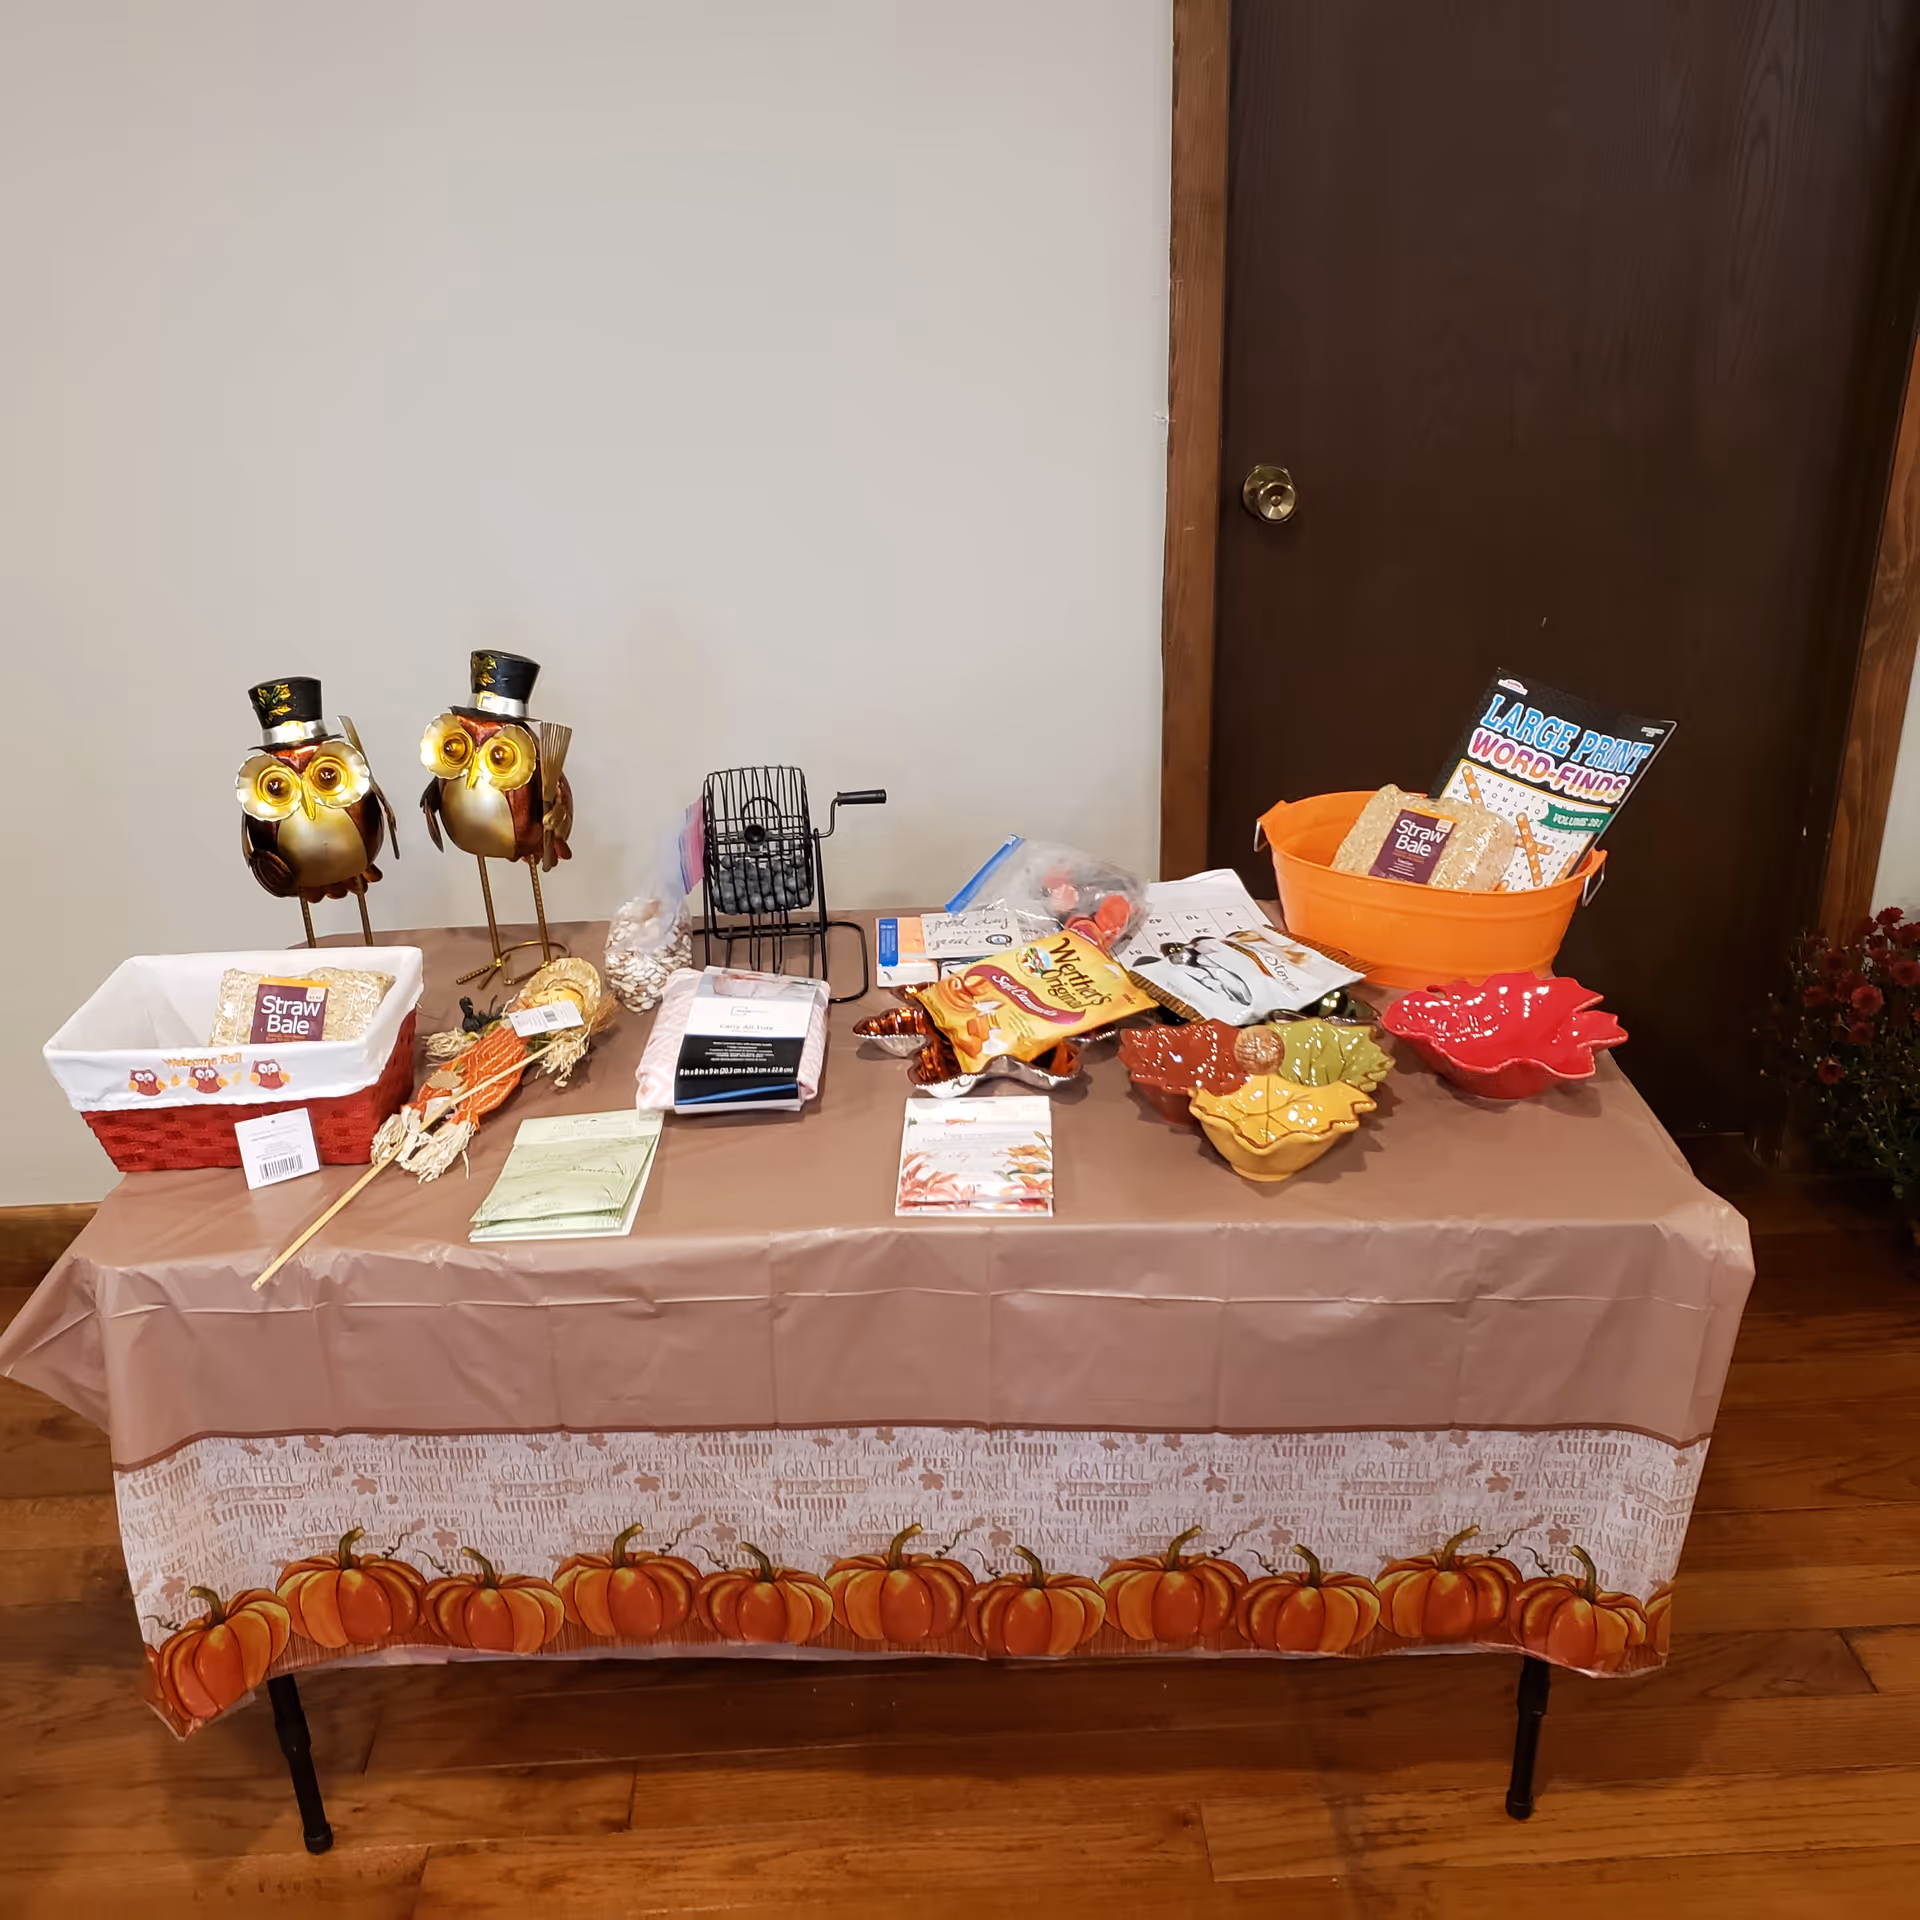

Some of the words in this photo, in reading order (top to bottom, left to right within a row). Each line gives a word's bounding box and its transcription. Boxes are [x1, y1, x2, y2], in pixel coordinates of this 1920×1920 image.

[1481, 694, 1580, 757] LARGE
[1573, 731, 1655, 774] PRINT
[1468, 727, 1630, 803] WORD-FINDS
[1396, 819, 1446, 843] Straw
[1395, 834, 1431, 856] Bale
[1049, 937, 1112, 1006] Werther's
[1041, 969, 1092, 1009] Original
[261, 995, 321, 1017] Straw
[267, 1014, 310, 1035] Bale
[408, 1444, 487, 1460] Autumn
[695, 1442, 772, 1457] Autumn
[983, 1441, 1058, 1457] Autumn
[1271, 1443, 1346, 1458] Autumn
[1557, 1441, 1632, 1458] Autumn
[352, 1462, 380, 1474] PIE
[637, 1460, 665, 1471] PIE
[784, 1459, 860, 1477] GRATEFUL
[922, 1458, 950, 1469] PIE
[1068, 1462, 1149, 1481] GRATEFUL
[1208, 1463, 1234, 1473] PIE
[1355, 1461, 1433, 1479] GRATEFUL
[1491, 1461, 1520, 1471] PIE
[126, 1457, 201, 1500] Autumn
[216, 1466, 295, 1485] GRATEFUL
[501, 1464, 576, 1481] GRATEFUL
[661, 1472, 736, 1489] THANKFUL
[944, 1471, 1019, 1491] THANKFUL
[1510, 1472, 1587, 1490] THANKFUL
[377, 1475, 454, 1493] THANKFUL
[1226, 1474, 1306, 1492] THANKFUL
[491, 1498, 567, 1513] Autumn
[774, 1494, 847, 1510] Autumn
[1055, 1497, 1129, 1512] Autumn
[1338, 1496, 1412, 1511] Autumn
[209, 1503, 287, 1527] Autumn
[992, 1516, 1019, 1526] PIE
[1273, 1515, 1300, 1525] PIE
[1553, 1513, 1580, 1525] PIE
[458, 1529, 534, 1546] THANKFUL
[739, 1525, 809, 1542] THANKFUL
[1013, 1528, 1091, 1545] THANKFUL
[1294, 1526, 1372, 1545] THANKFUL
[1572, 1527, 1650, 1563] THANKFUL
